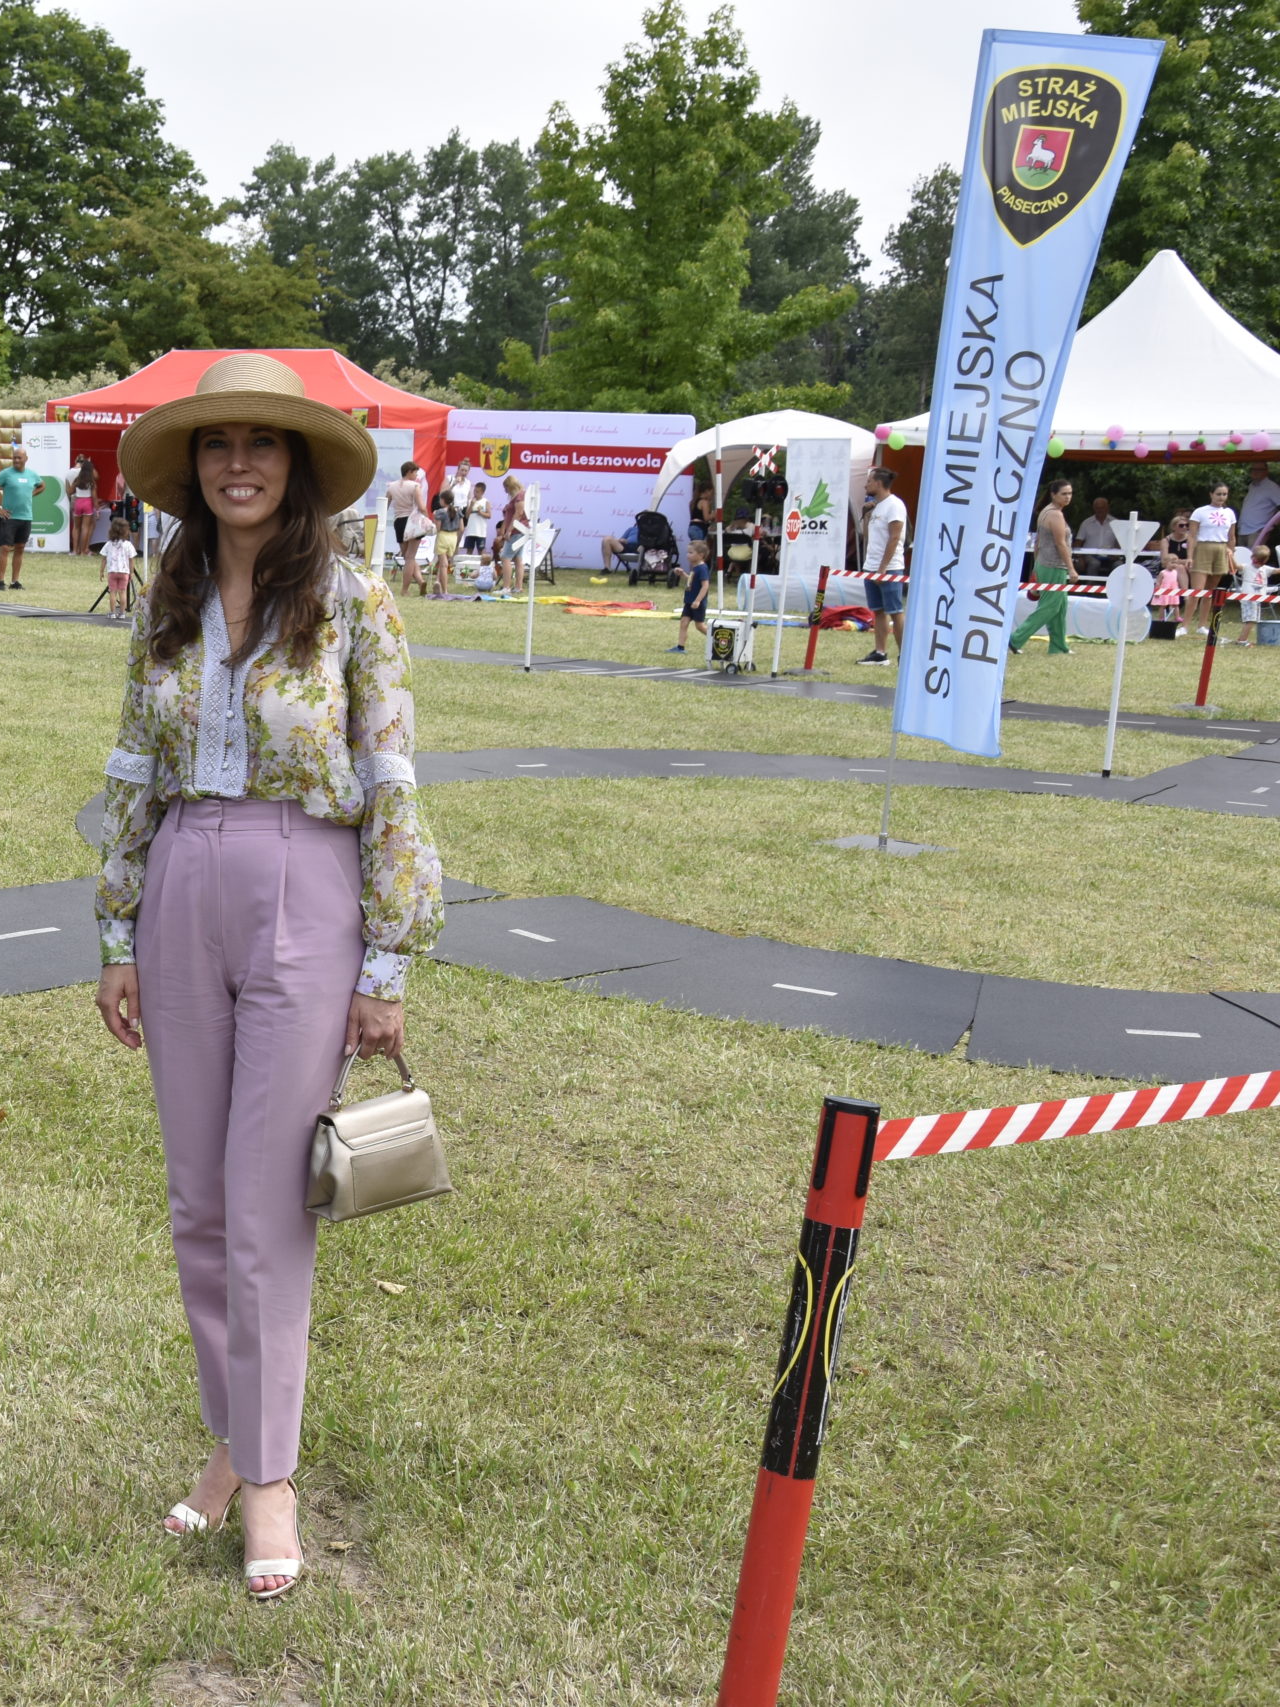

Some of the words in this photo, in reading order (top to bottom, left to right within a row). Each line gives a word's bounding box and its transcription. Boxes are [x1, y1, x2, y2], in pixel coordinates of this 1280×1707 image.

[1018, 76, 1097, 103] STRAŻ
[1001, 99, 1099, 129] MIEJSKA
[996, 185, 1069, 215] PIASECZNO
[942, 273, 1005, 506] MIEJSKA
[73, 410, 123, 425] GMINA
[520, 450, 569, 466] Gmina
[572, 451, 661, 469] Lesznowola
[961, 350, 1046, 665] PIASECZNO
[786, 519, 801, 532] STOP
[924, 522, 965, 699] STRAŻ
